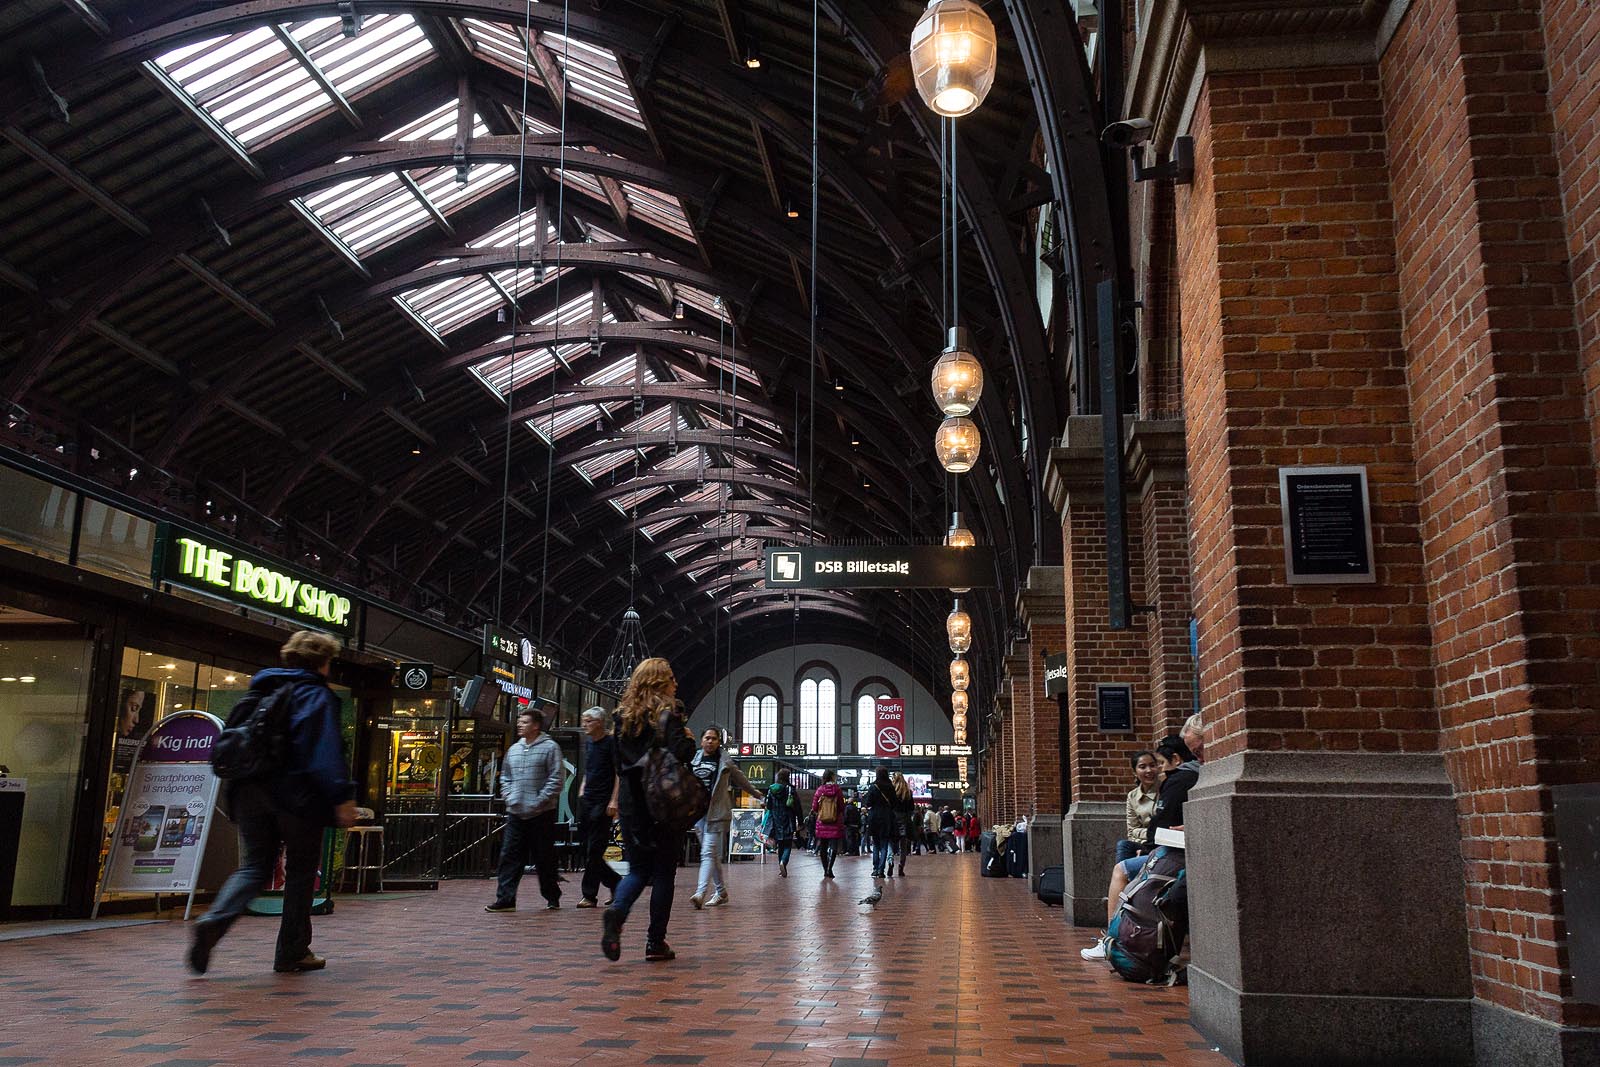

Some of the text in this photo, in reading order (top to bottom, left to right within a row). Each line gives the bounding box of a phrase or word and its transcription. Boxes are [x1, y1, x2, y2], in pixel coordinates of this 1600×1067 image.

[176, 538, 232, 587] THE
[231, 560, 300, 608] BODY
[815, 560, 909, 575] DSB Billetsalg
[879, 712, 901, 720] Zone
[157, 735, 213, 751] Kig ind!
[144, 773, 206, 784] Smartphones
[143, 784, 203, 795] til småpenge!
